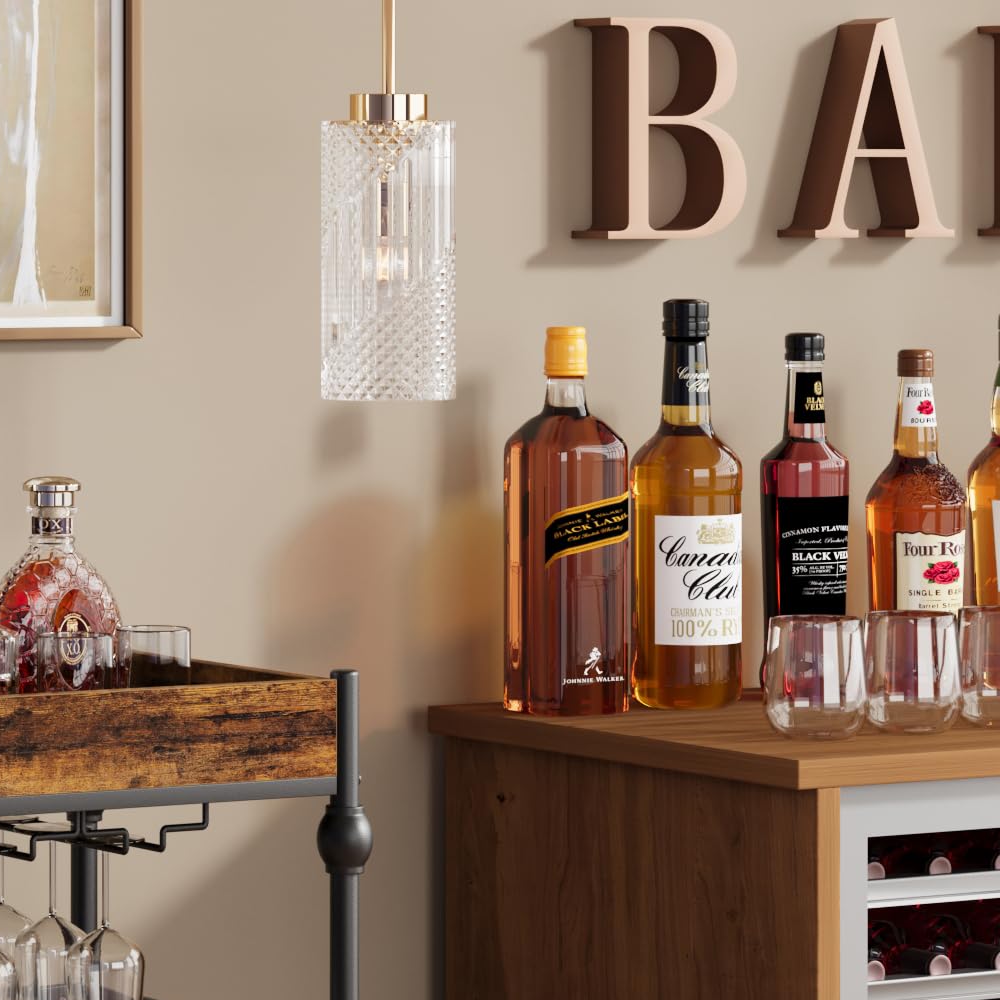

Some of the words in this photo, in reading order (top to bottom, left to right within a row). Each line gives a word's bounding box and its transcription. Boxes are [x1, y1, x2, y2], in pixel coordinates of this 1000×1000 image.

[572, 17, 1000, 239] BA
[553, 523, 592, 539] BLACK
[781, 526, 820, 539] CINNAMON
[659, 535, 742, 568] Canad
[791, 551, 832, 561] BLACK
[903, 541, 938, 557] Four
[938, 541, 966, 557] Ro
[791, 565, 808, 575] 35%
[671, 619, 718, 638] 100%
[562, 677, 594, 686] JOHNNIE
[595, 675, 626, 683] WALKER
